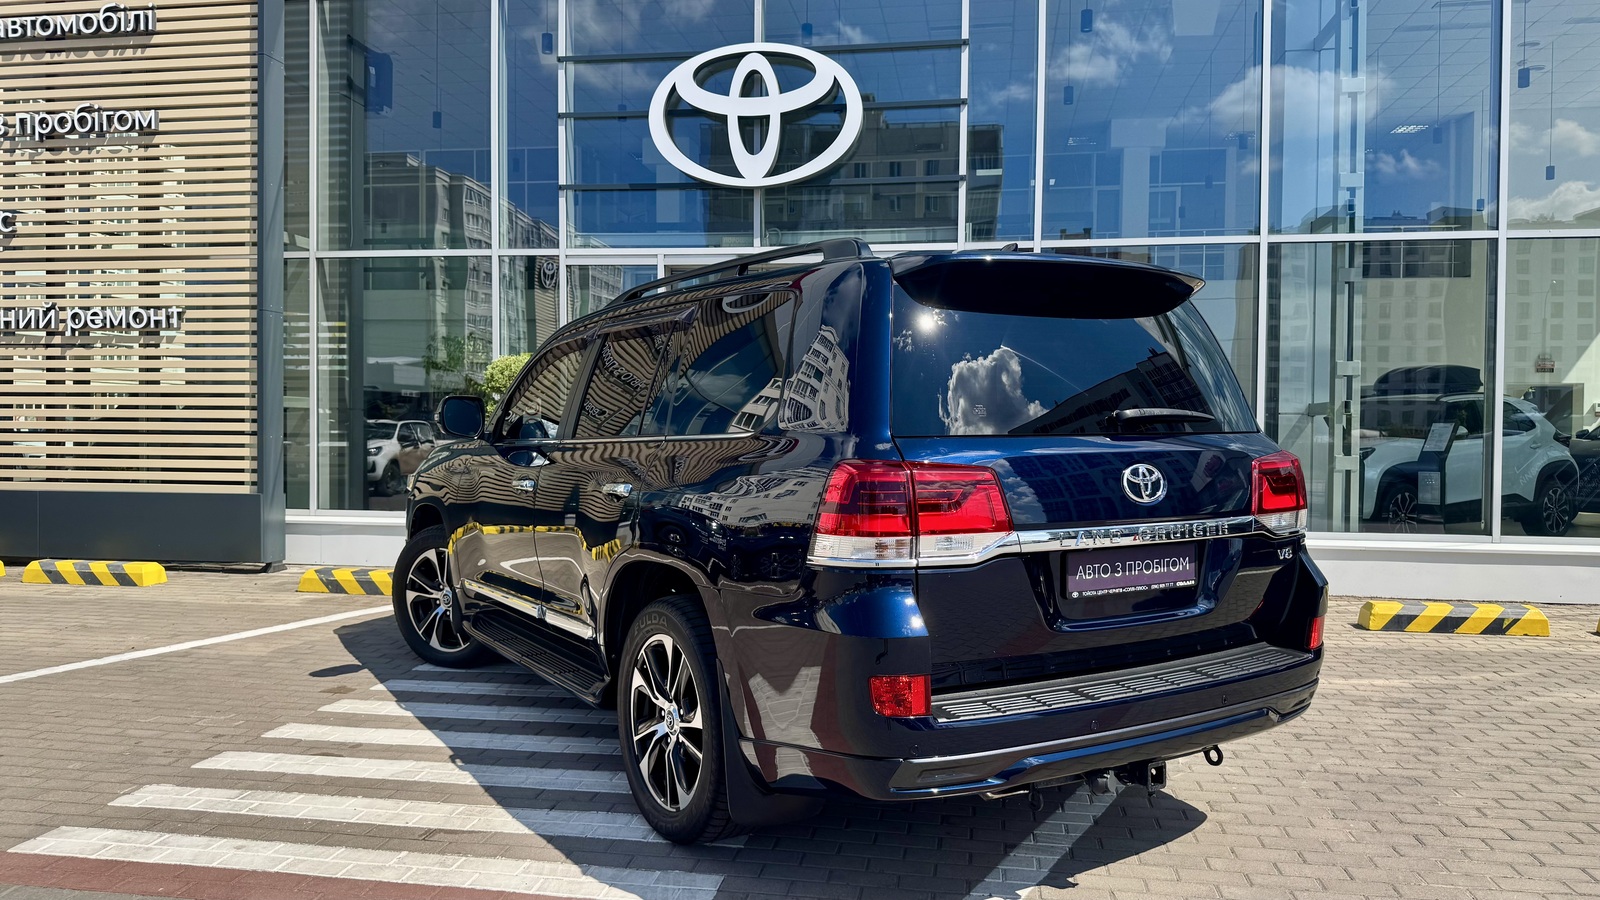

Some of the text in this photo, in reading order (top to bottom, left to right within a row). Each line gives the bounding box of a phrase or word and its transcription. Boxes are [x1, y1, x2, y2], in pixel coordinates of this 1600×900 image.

[15, 103, 159, 142] пробігом
[66, 306, 186, 337] ремонт
[1059, 521, 1229, 548] LAND CRUISER
[1277, 547, 1293, 560] V8
[1076, 563, 1111, 580] АВТО
[1125, 557, 1190, 576] ПРОБІГОМ
[634, 613, 668, 636] FULDA
